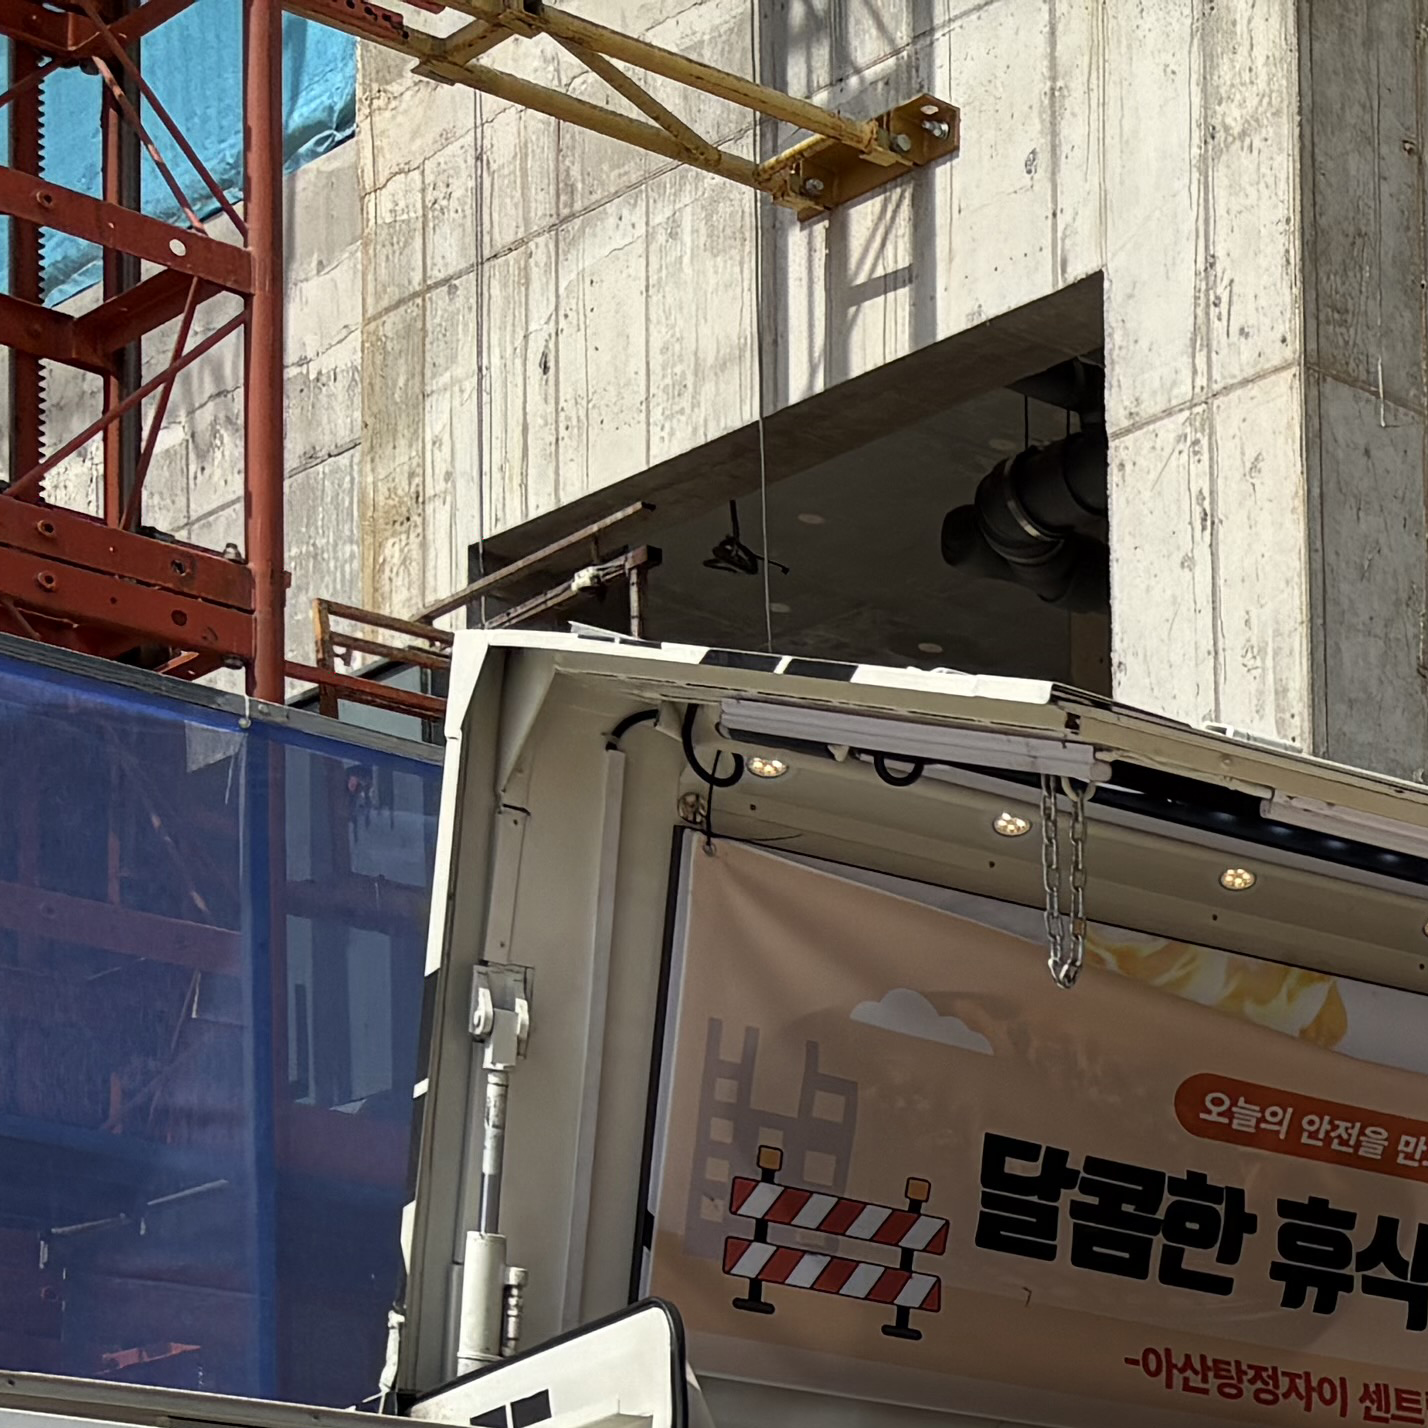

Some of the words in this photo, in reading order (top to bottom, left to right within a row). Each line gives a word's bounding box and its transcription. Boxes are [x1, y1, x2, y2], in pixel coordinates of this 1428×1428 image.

[1199, 1092, 1293, 1140] 오늘의
[1301, 1113, 1390, 1158] 안전을
[975, 1132, 1258, 1296] 달콤한
[1124, 1346, 1350, 1418] -아산탕정자이
